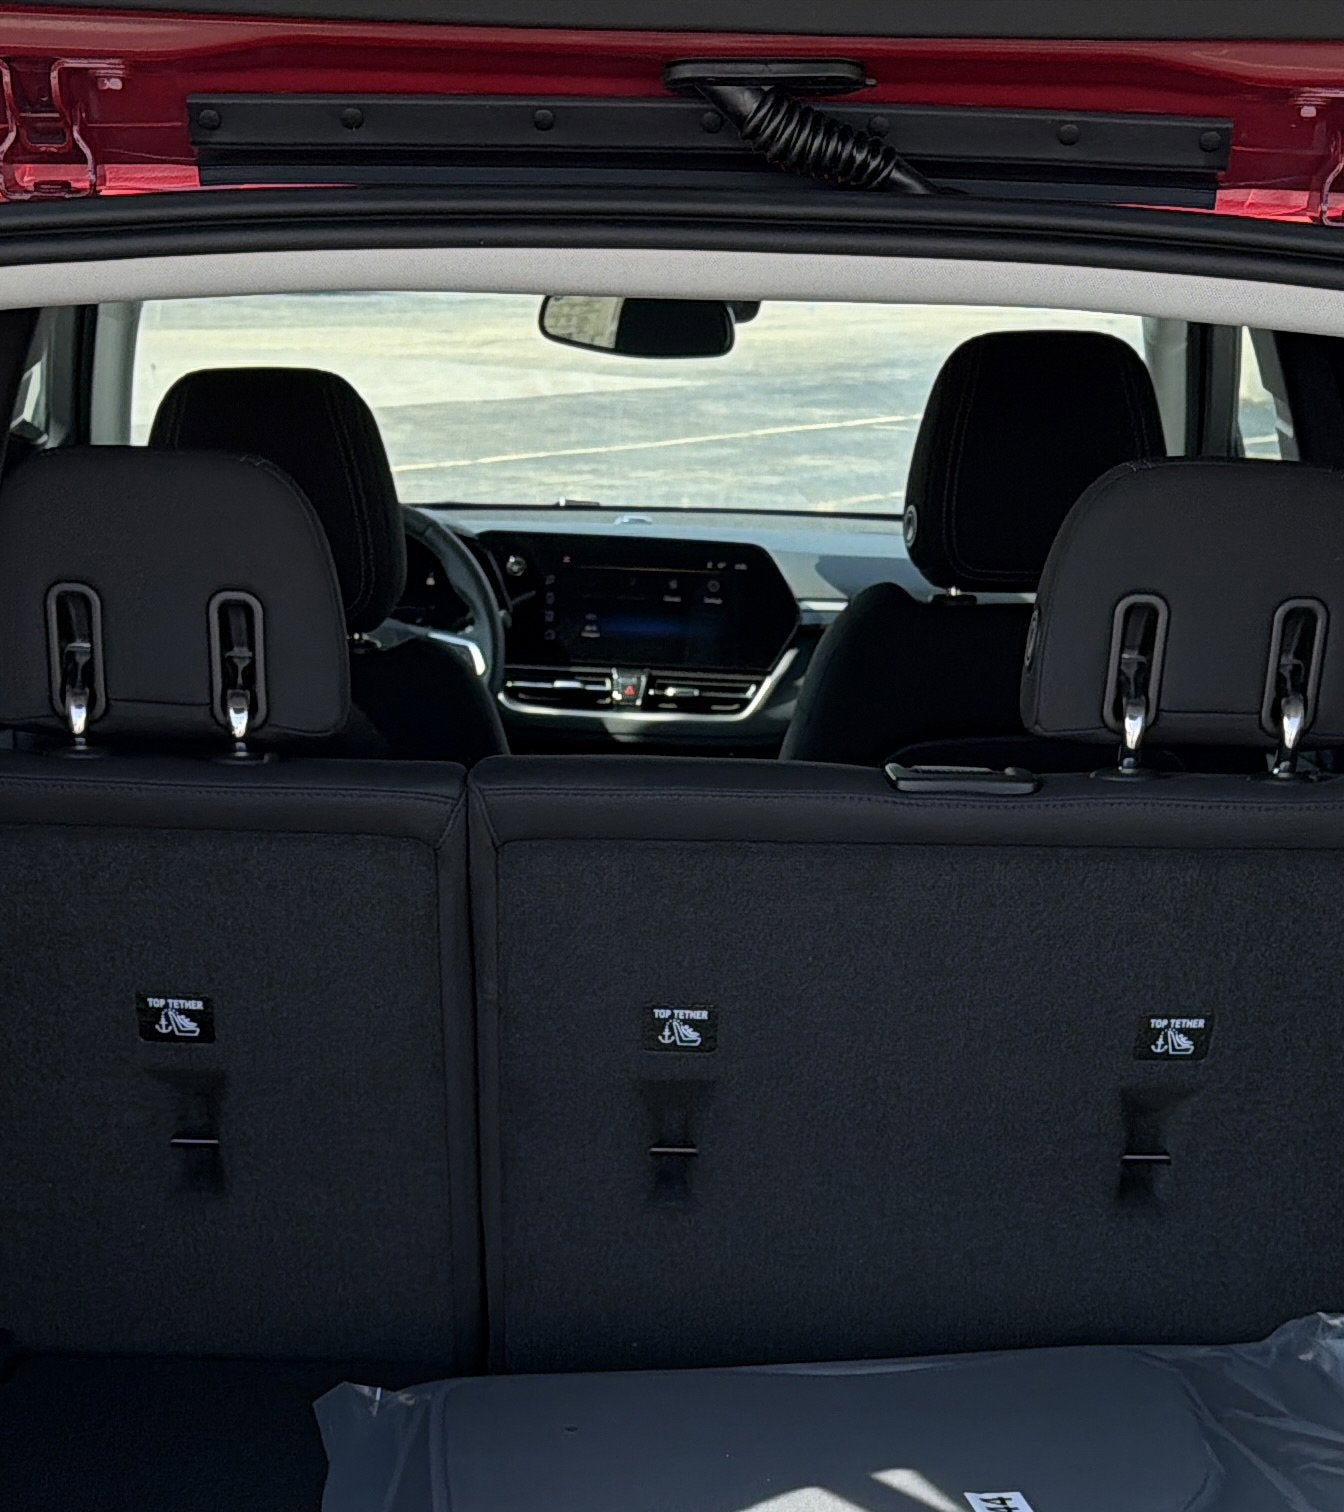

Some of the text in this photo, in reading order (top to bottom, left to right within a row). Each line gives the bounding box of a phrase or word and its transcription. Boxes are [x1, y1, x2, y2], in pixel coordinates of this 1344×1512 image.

[147, 997, 204, 1010] TOP TETHER
[653, 1008, 709, 1020] TOP TETHER
[1150, 1018, 1205, 1029] TOP TETHER
